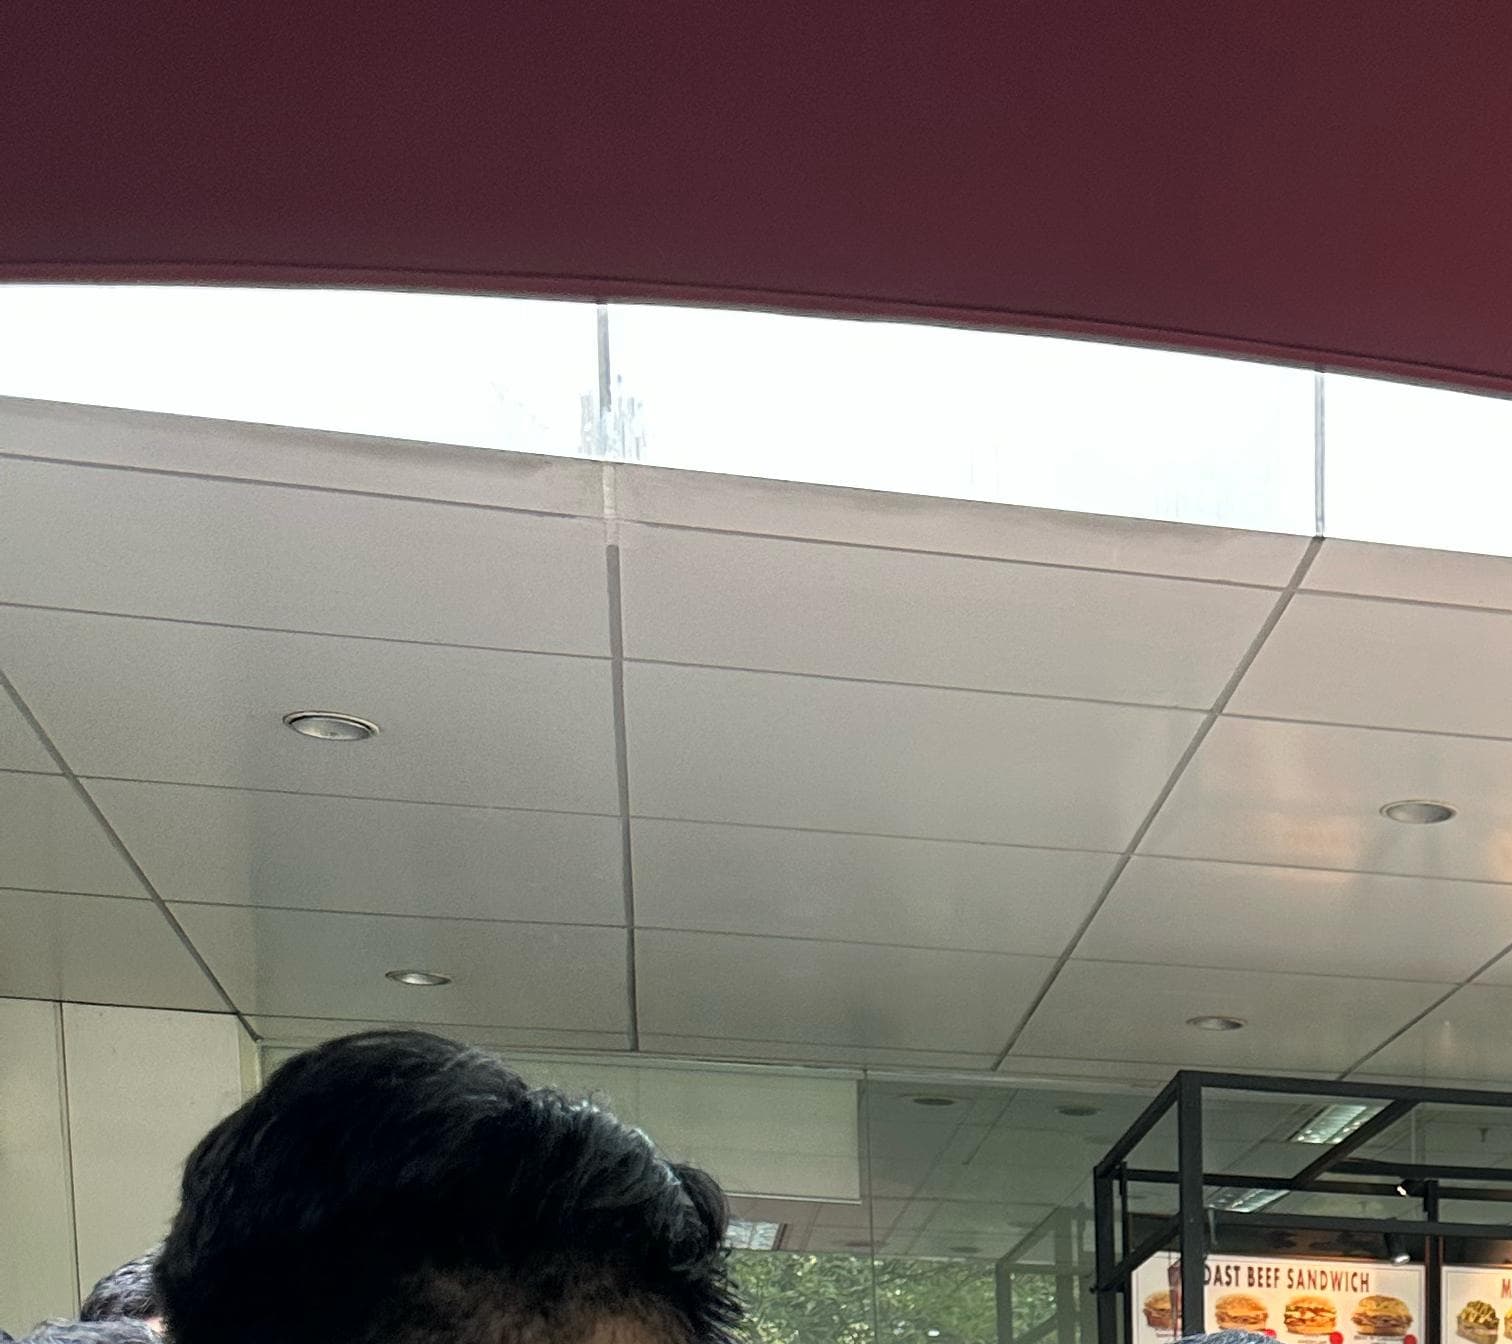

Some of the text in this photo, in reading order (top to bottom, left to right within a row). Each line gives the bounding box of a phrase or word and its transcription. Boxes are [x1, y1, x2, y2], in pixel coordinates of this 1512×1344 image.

[1202, 1264, 1370, 1293] OAST BEEF SANDWICH
